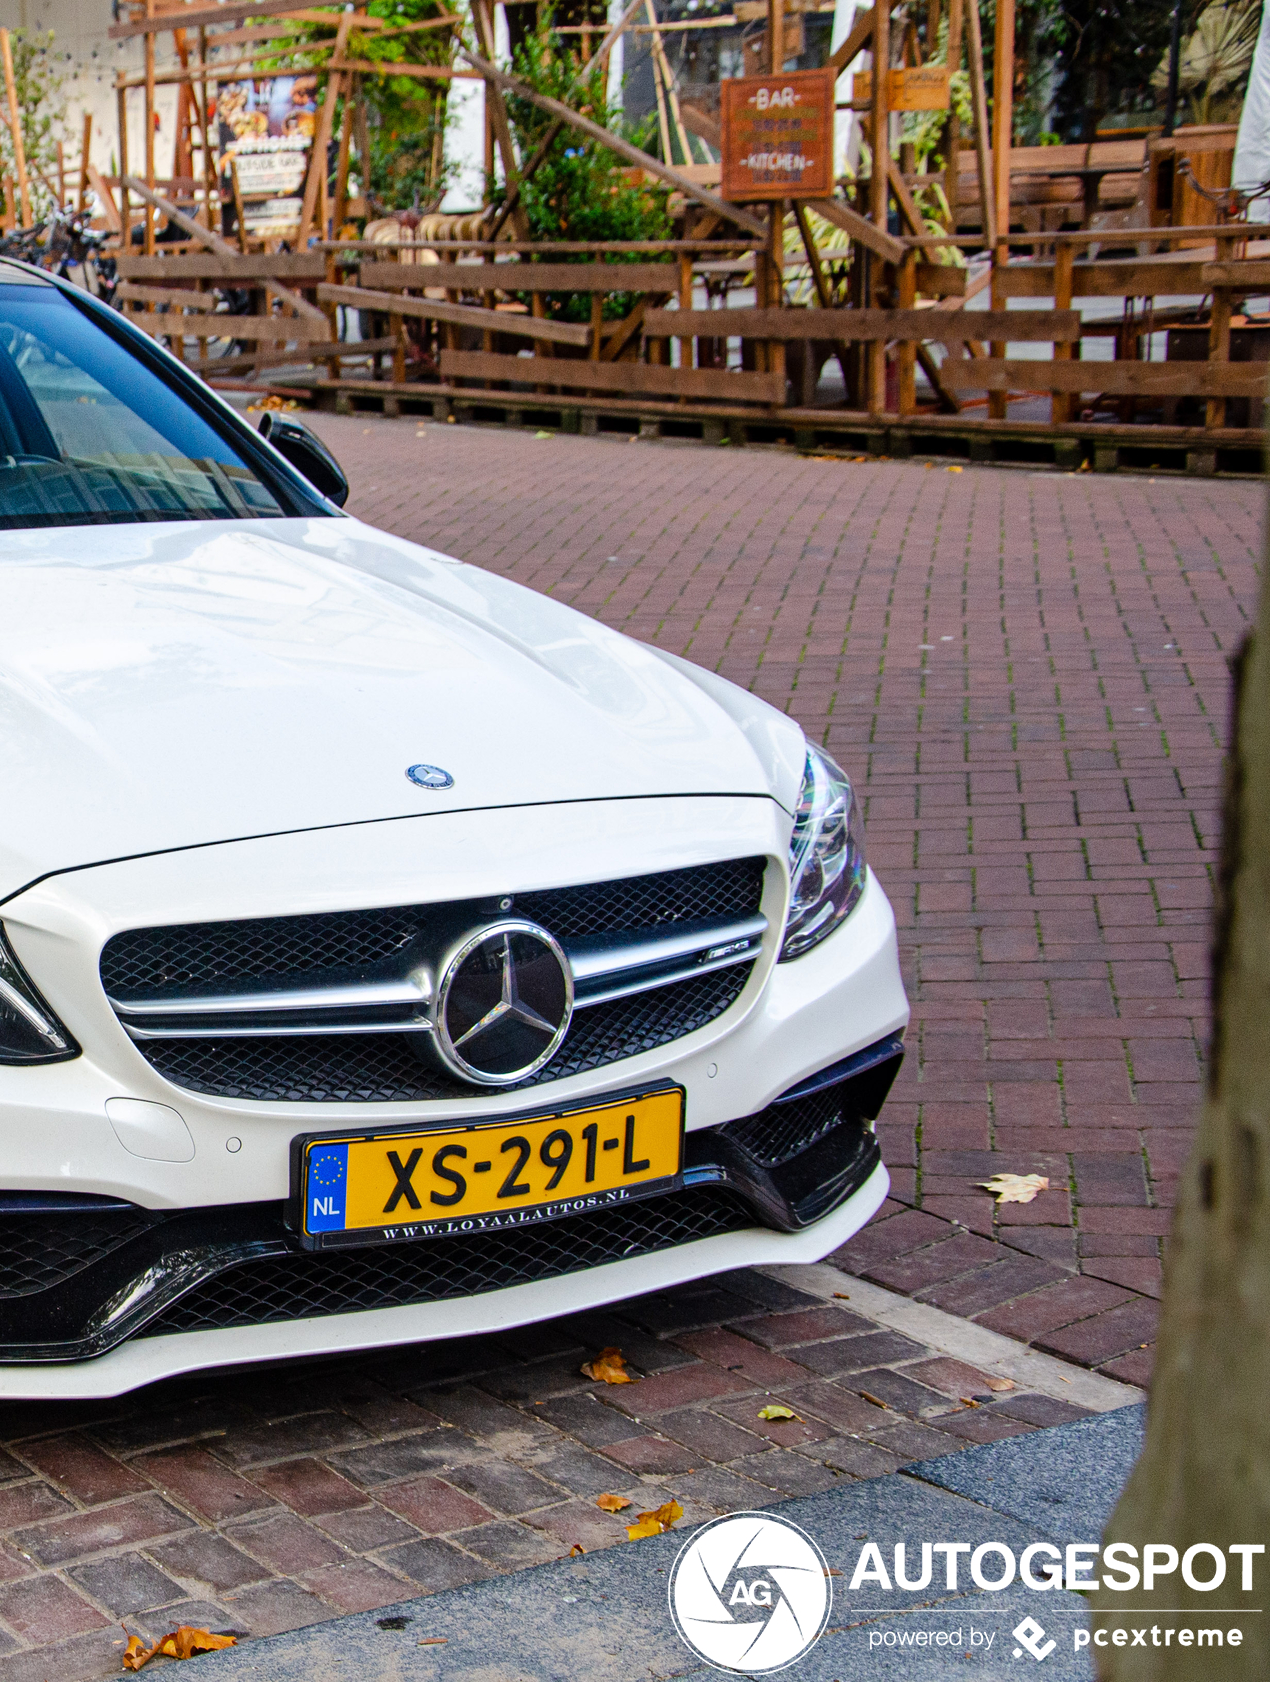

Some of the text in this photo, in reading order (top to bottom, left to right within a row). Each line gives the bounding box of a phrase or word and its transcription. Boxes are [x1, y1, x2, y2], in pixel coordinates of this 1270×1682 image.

[383, 1115, 650, 1213] XS-291-L
[313, 1197, 341, 1217] NL
[382, 1190, 630, 1240] WWW.LOYAALAUTOS.NL
